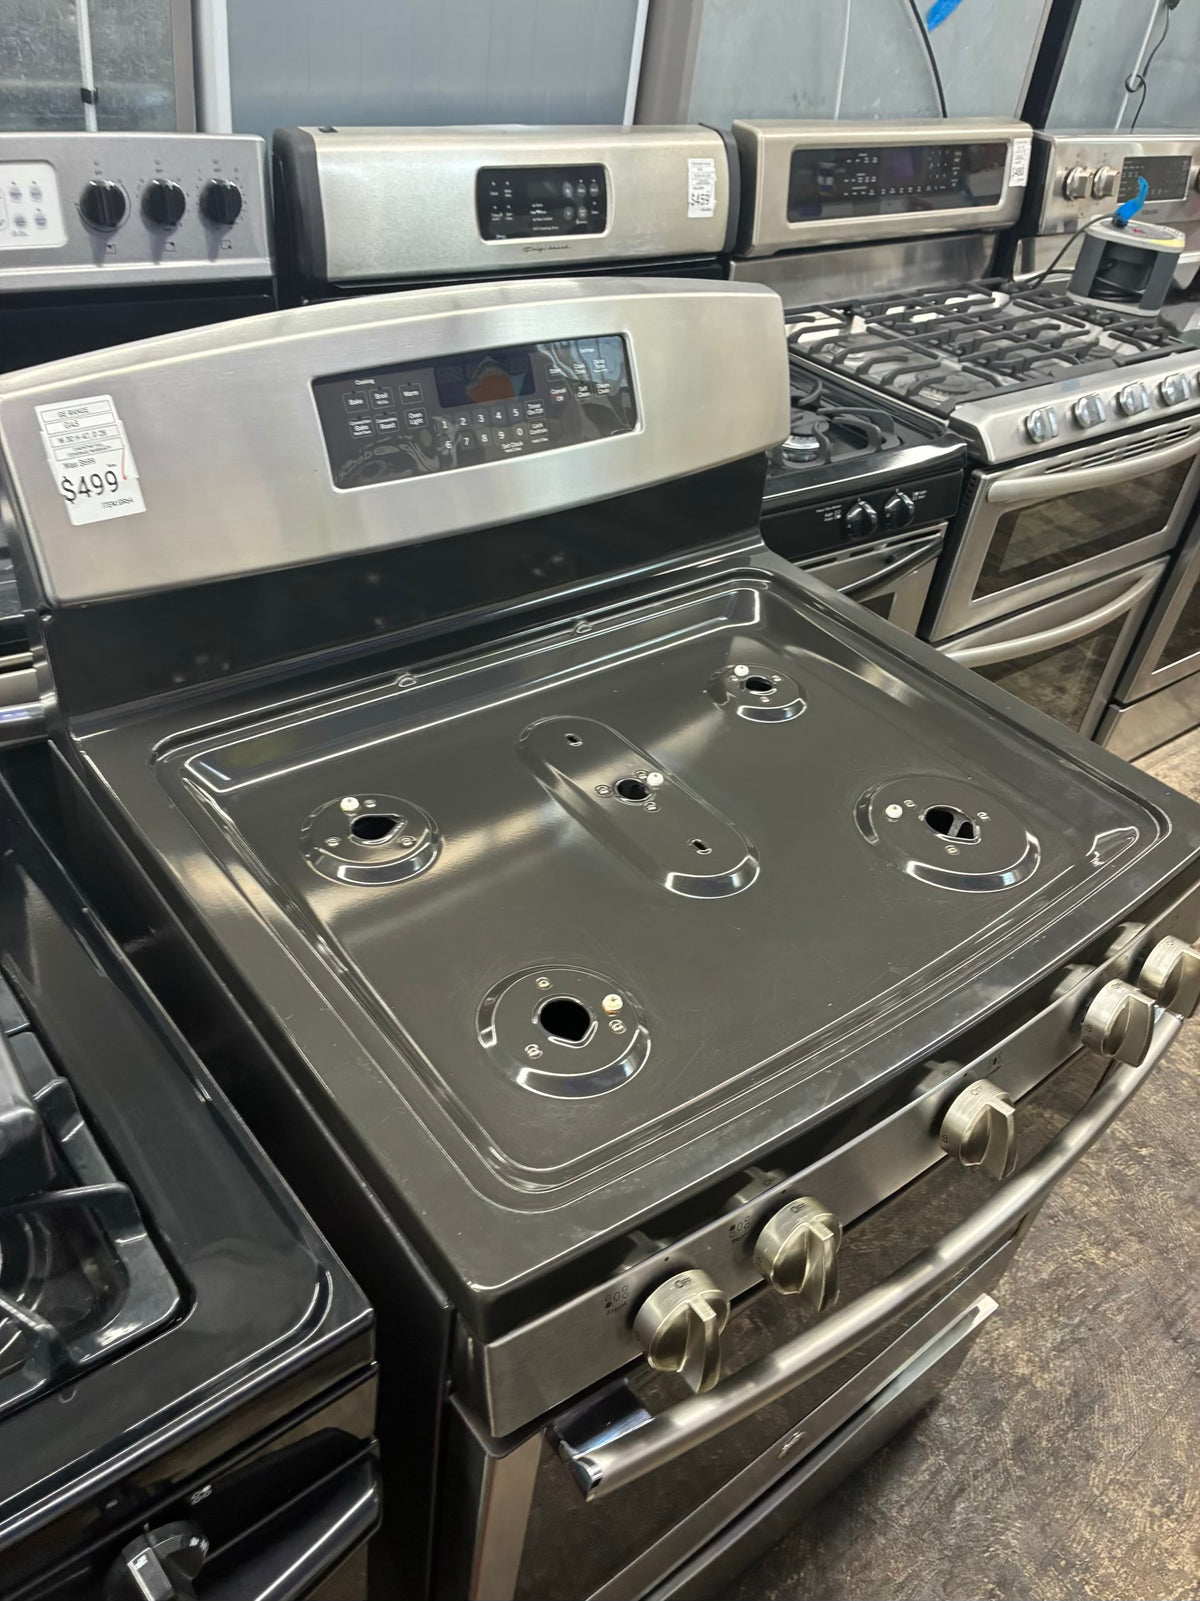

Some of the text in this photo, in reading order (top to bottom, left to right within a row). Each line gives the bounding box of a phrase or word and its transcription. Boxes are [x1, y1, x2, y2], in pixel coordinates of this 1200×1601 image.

[63, 420, 80, 429] GAS
[442, 408, 520, 429] 1 2 3 4 5
[445, 428, 523, 449] 6 7 8 9 0
[61, 470, 119, 504] $499
